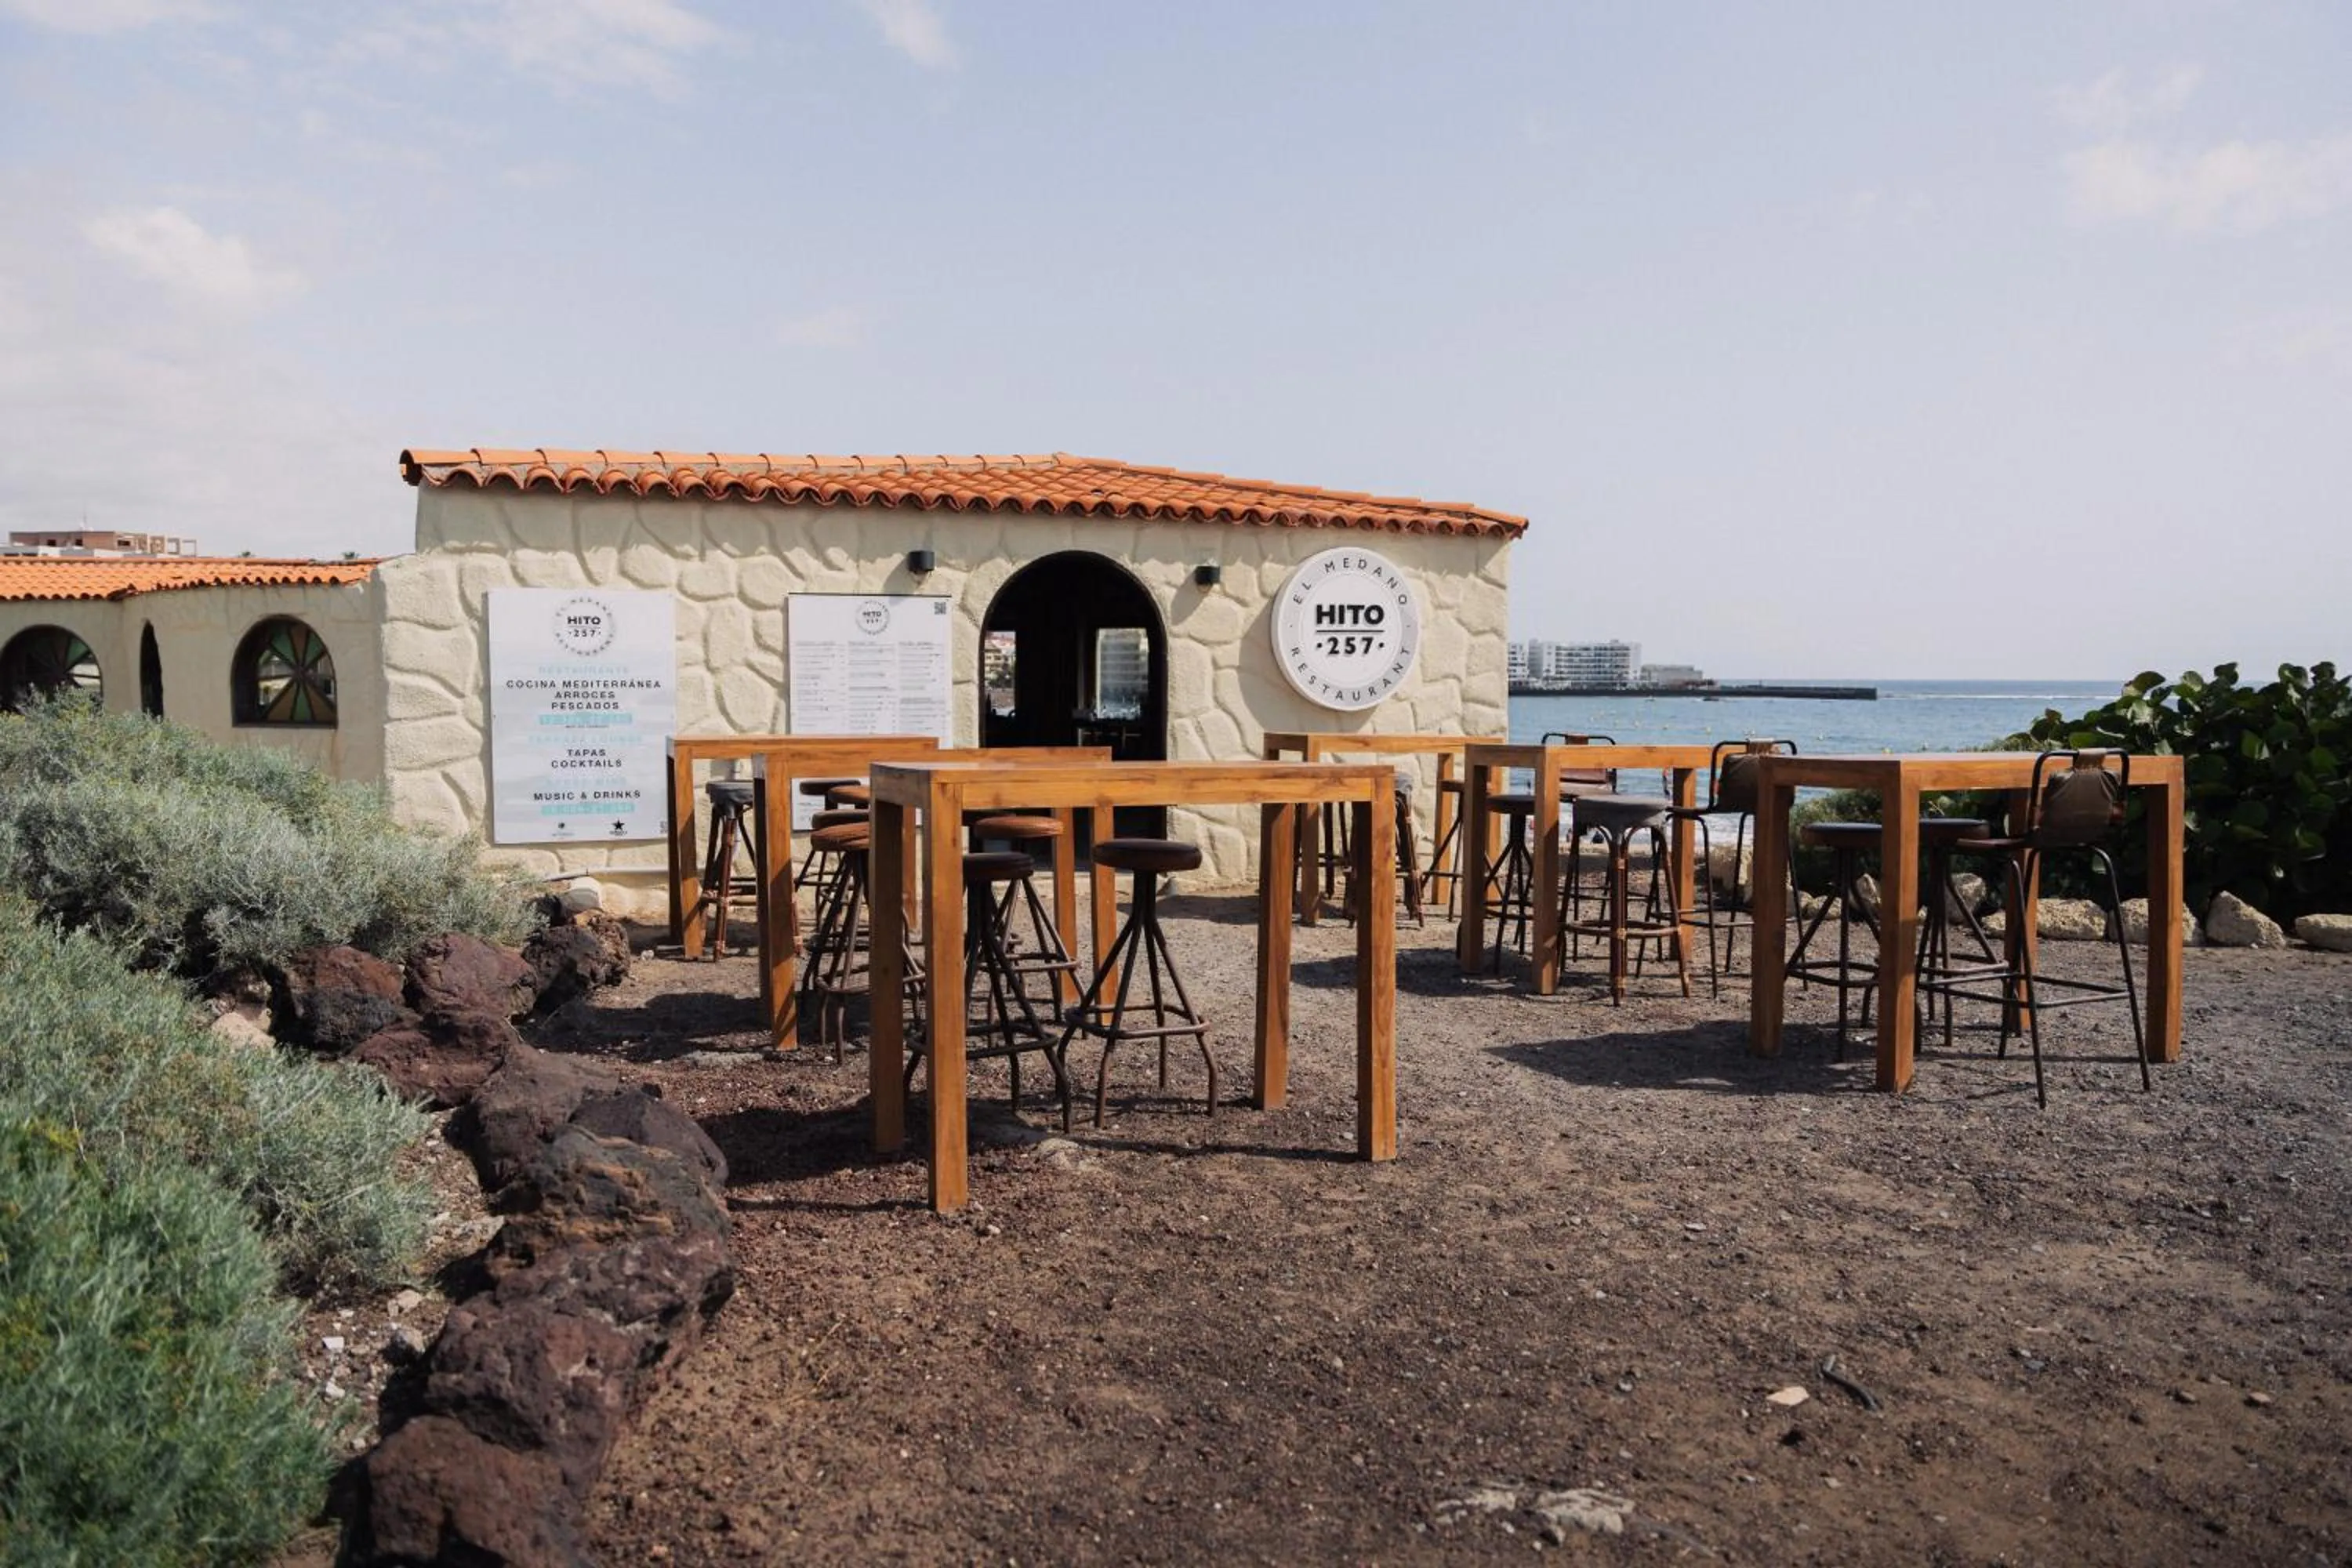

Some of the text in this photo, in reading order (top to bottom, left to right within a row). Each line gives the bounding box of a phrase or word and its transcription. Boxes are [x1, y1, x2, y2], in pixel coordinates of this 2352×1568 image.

[1293, 557, 1408, 604] EL MEDANO
[567, 615, 601, 625] HITO
[1316, 604, 1385, 625] HITO
[1327, 637, 1374, 655] 257
[1290, 646, 1410, 701] RESTAURANT
[506, 678, 661, 688] COCINA MEDITERRÁNEA
[551, 759, 622, 768] COCKTAILS
[534, 792, 575, 800] MUSIC
[593, 790, 641, 799] DRINKS
